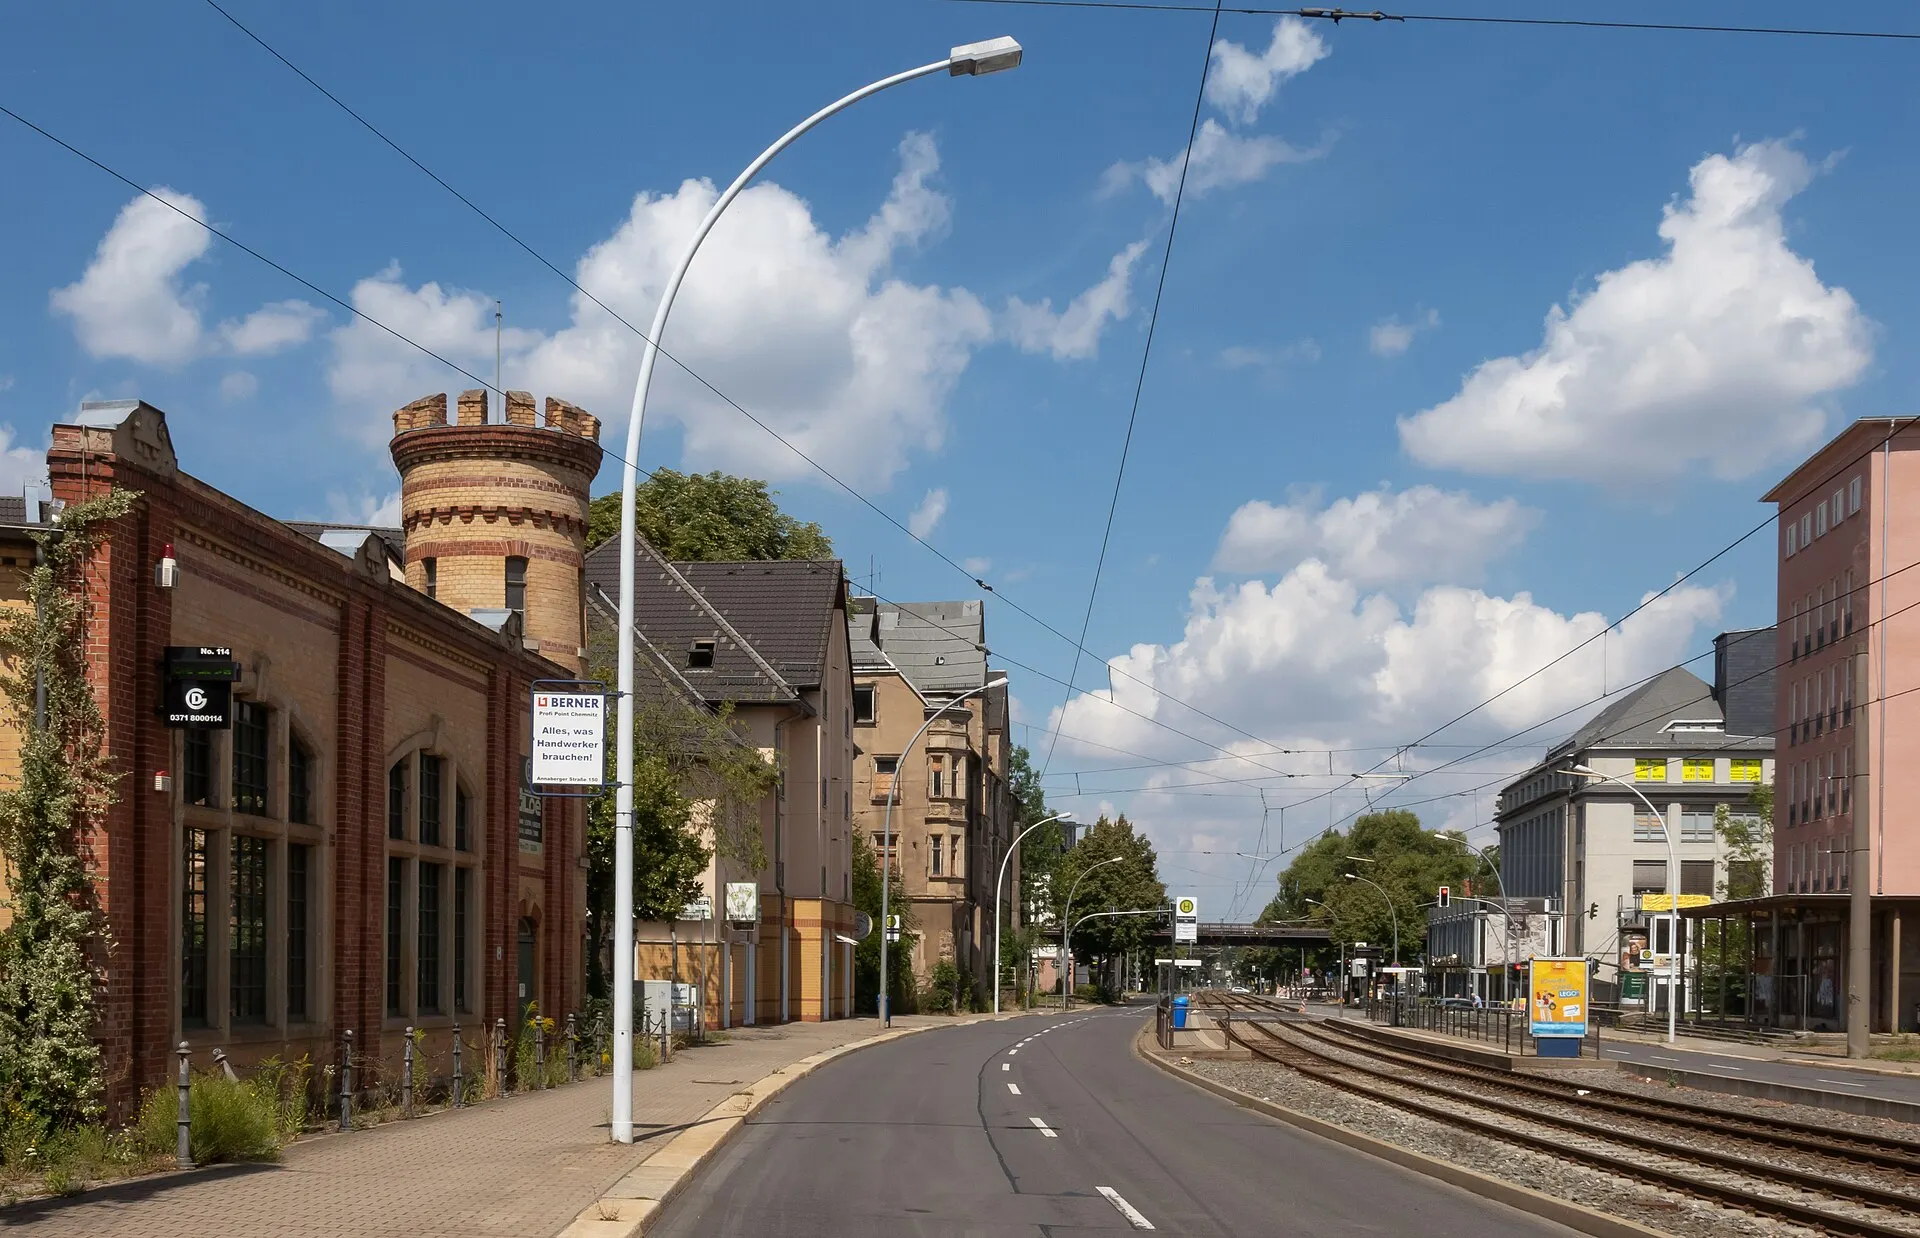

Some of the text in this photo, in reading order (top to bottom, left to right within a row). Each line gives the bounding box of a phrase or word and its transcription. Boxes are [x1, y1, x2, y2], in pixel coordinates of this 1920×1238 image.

[216, 648, 230, 656] 114
[551, 697, 600, 709] BERNER
[189, 714, 223, 722] 8000114
[542, 726, 571, 736] Alles,
[537, 739, 599, 749] Handwerker
[542, 752, 593, 761] brauchen!
